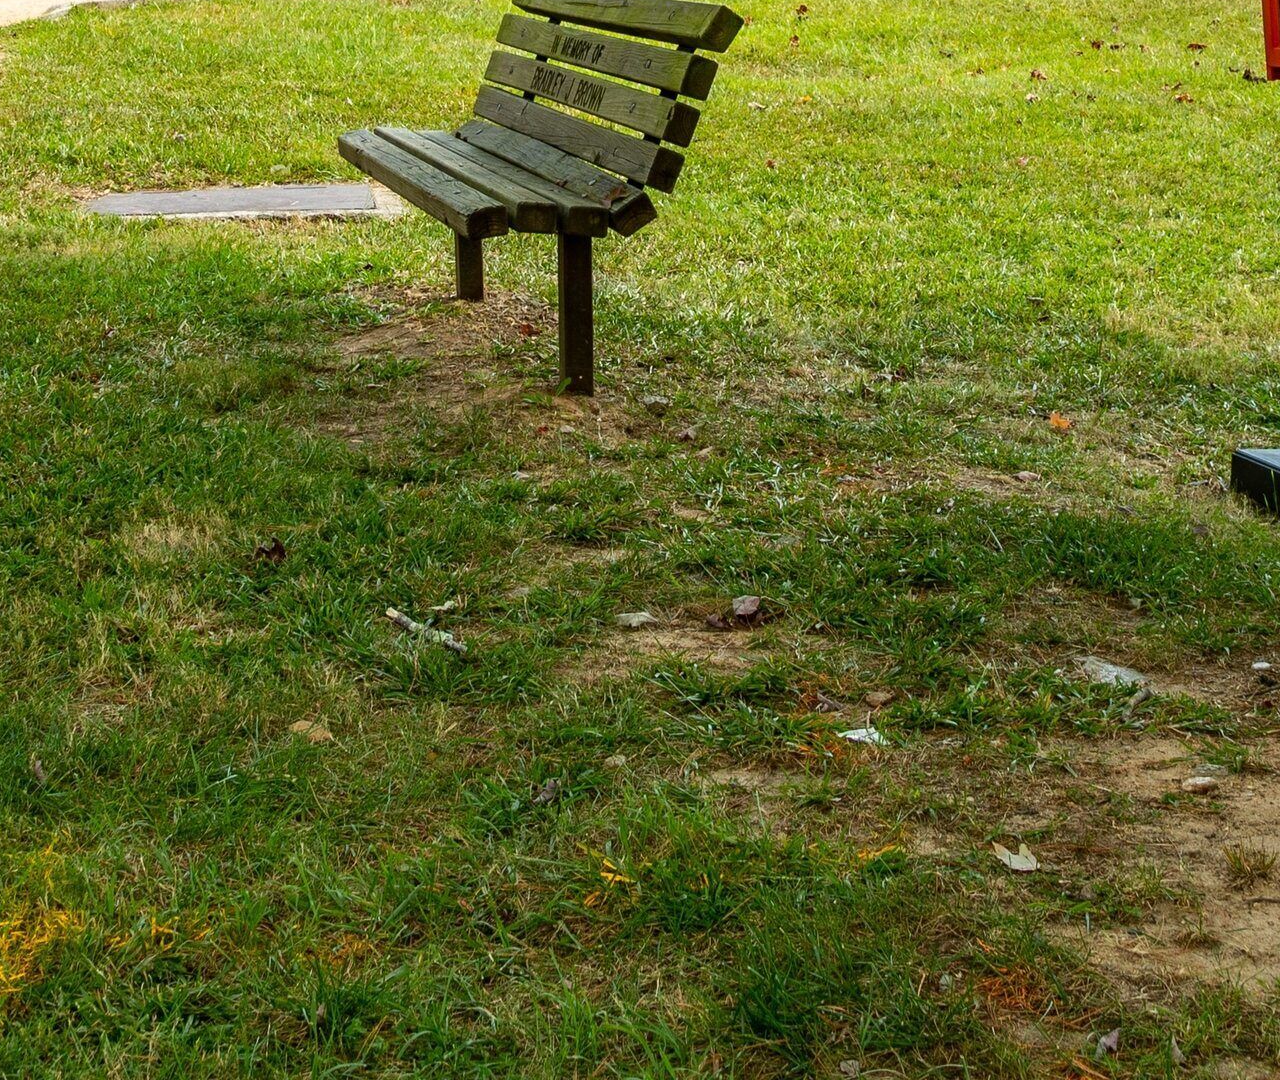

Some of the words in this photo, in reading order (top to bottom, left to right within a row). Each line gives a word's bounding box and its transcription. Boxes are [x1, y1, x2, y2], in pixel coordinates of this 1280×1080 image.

[551, 34, 562, 54] IN
[561, 36, 592, 62] MEMORY
[591, 43, 606, 65] OF
[530, 66, 567, 99] BRADLEY
[564, 77, 576, 102] J
[572, 78, 607, 113] BROWN
